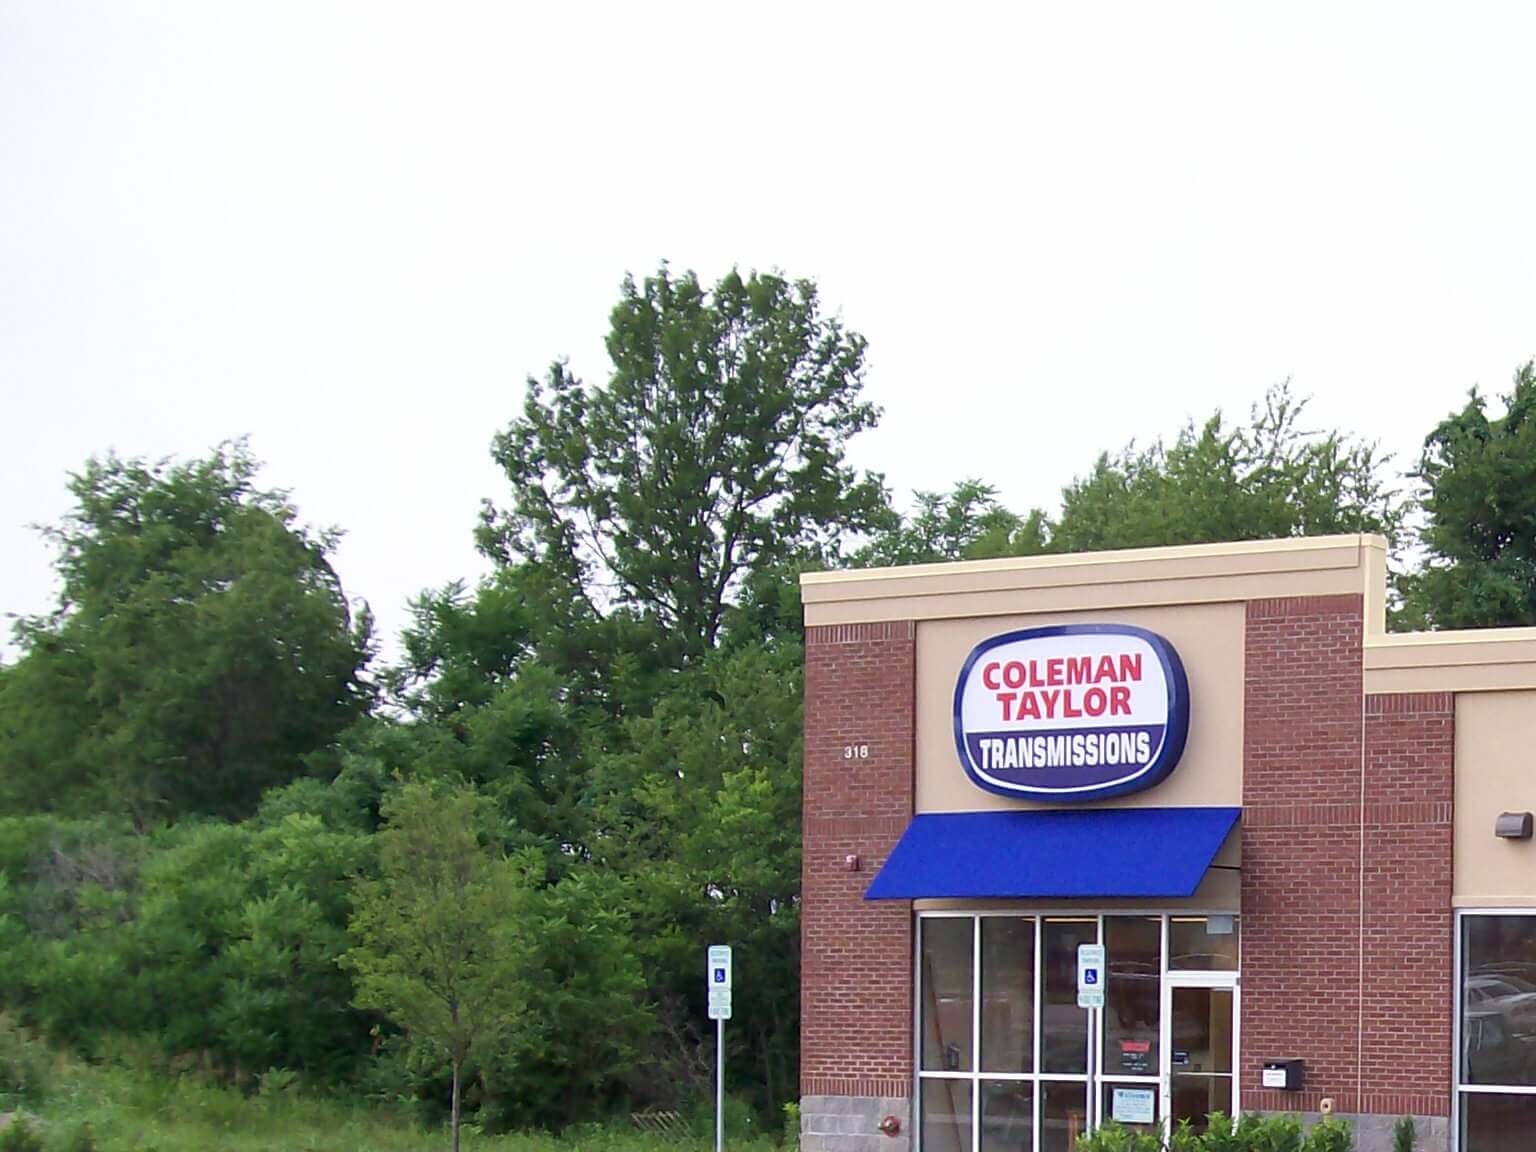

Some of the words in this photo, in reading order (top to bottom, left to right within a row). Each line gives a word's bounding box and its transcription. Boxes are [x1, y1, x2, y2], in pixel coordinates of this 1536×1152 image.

[983, 653, 1142, 690] COLEMAN
[996, 686, 1132, 721] TAYLOR
[844, 745, 869, 759] 318
[979, 731, 1150, 769] TRANSMISSIONS
